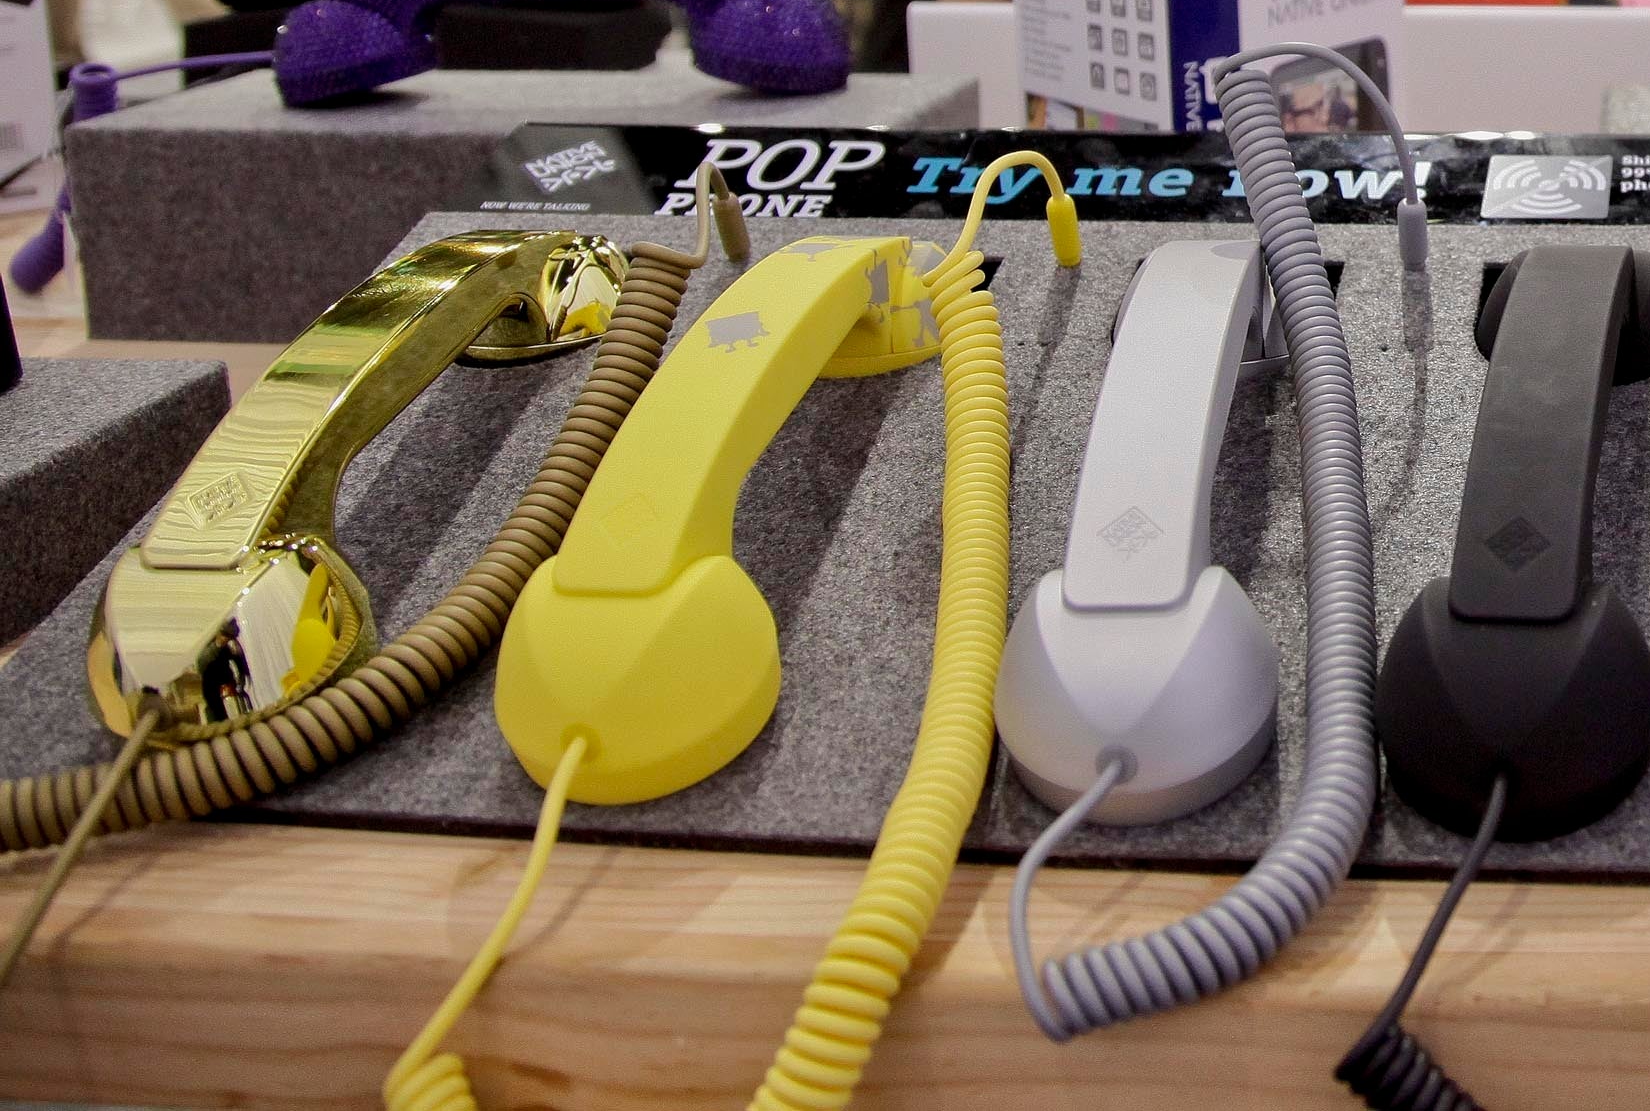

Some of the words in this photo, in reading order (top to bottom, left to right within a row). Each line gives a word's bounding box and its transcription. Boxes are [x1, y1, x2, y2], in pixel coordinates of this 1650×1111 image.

[674, 138, 886, 191] POP
[906, 157, 1043, 205] Try
[1065, 166, 1195, 197] me
[480, 201, 506, 210] NOW
[543, 202, 591, 211] TALKING
